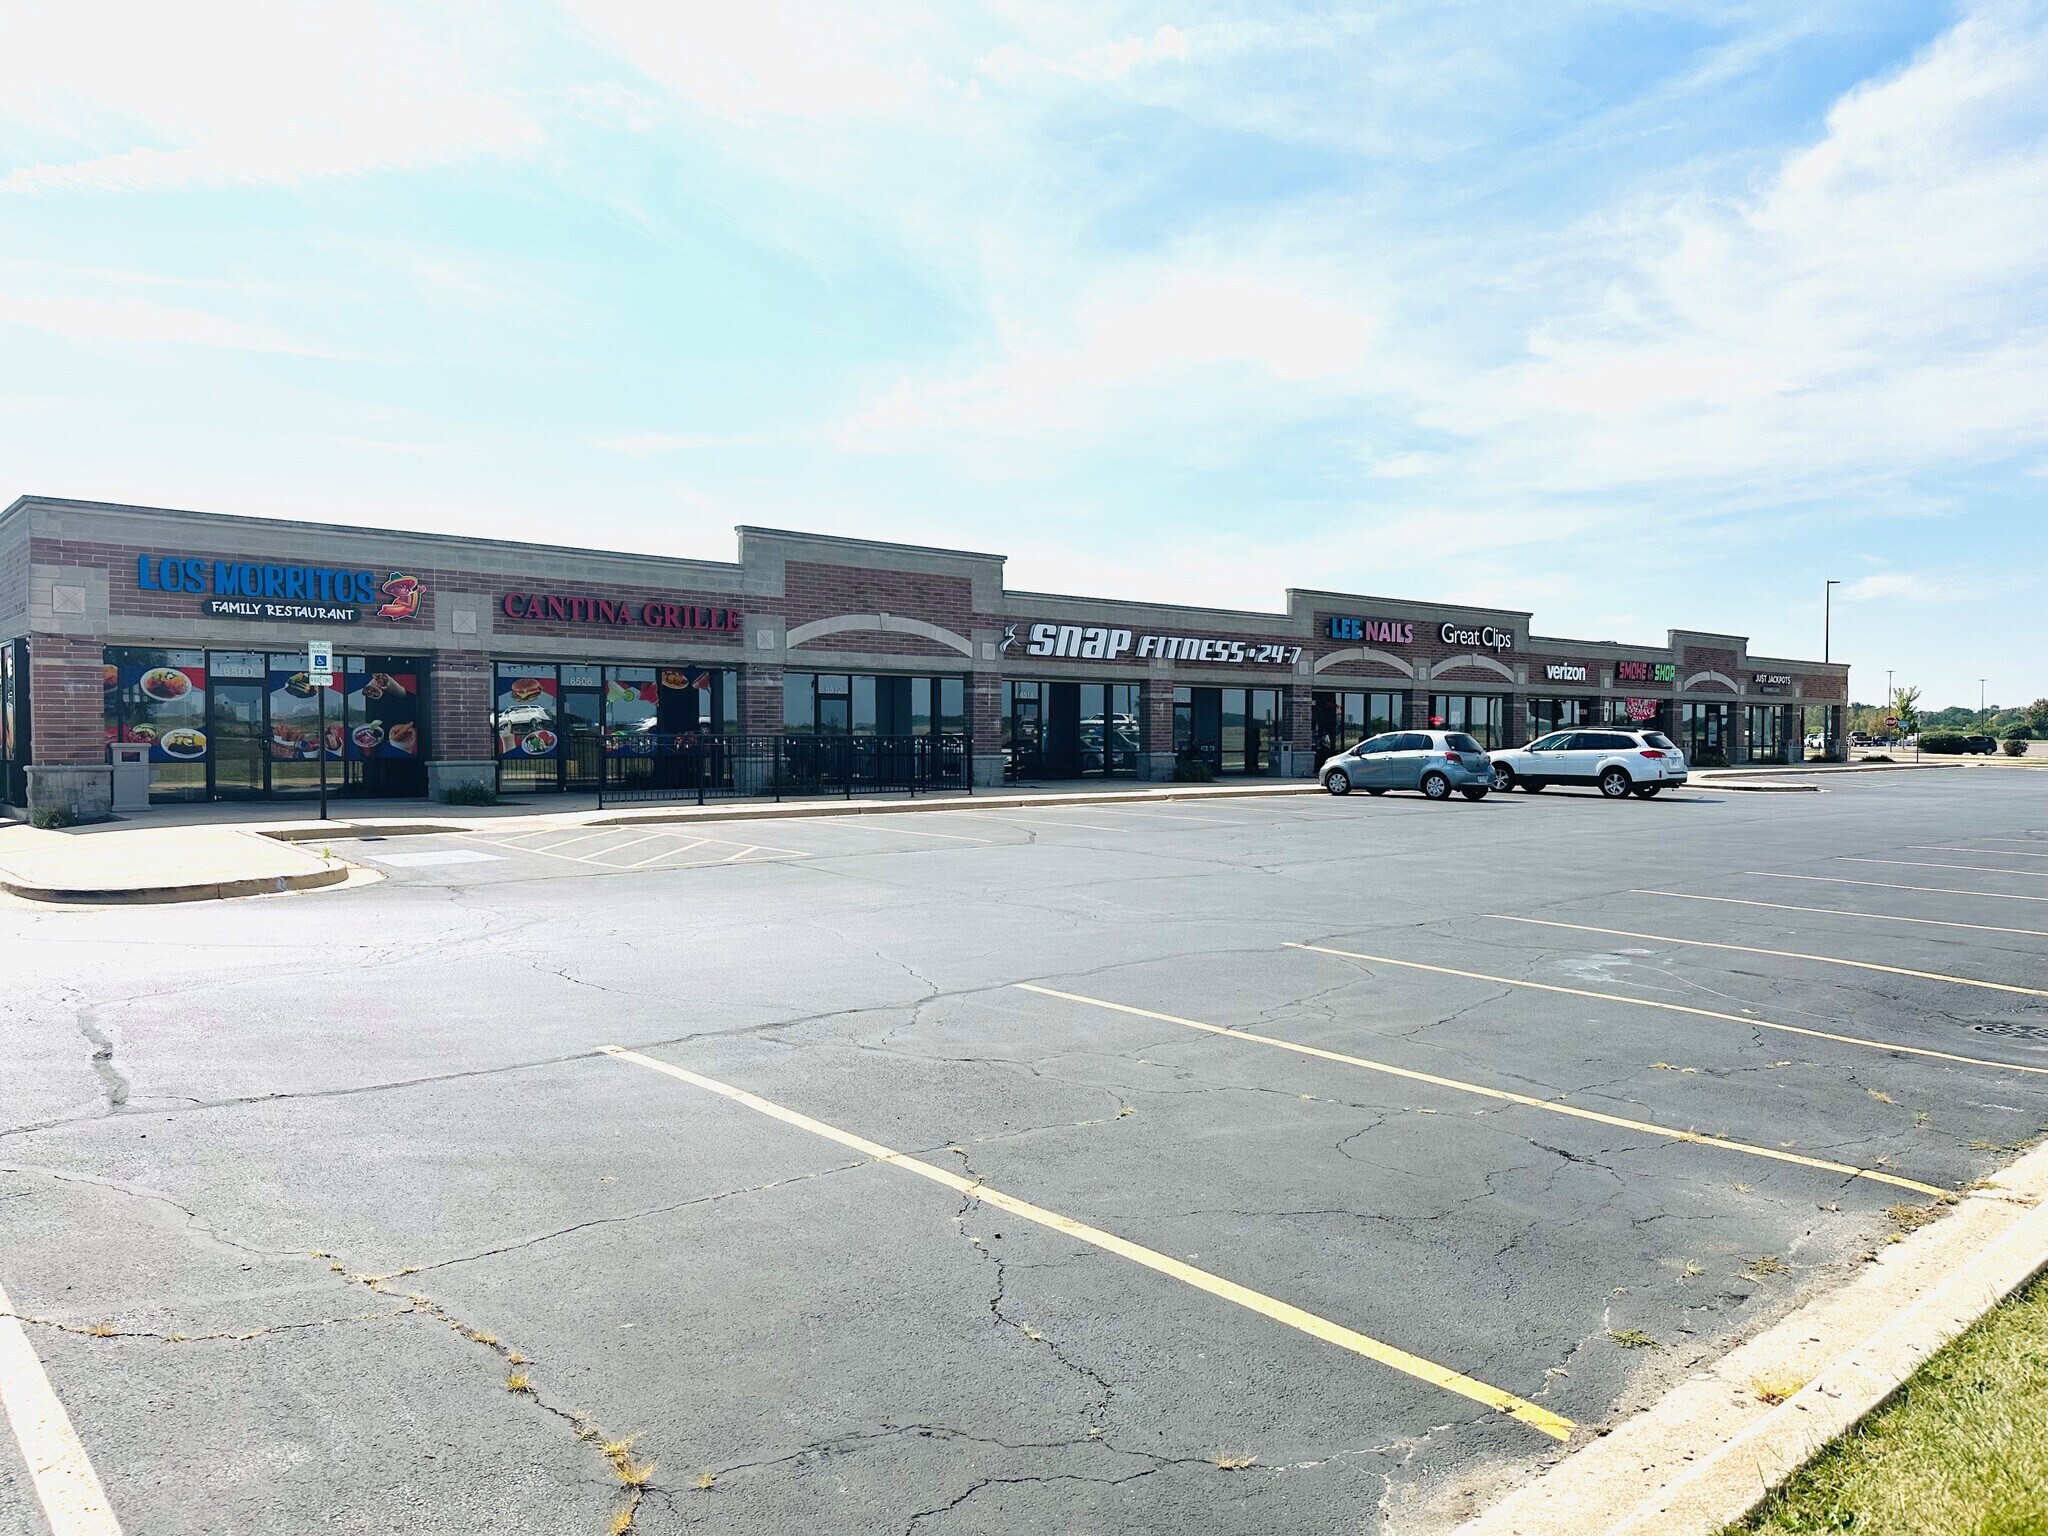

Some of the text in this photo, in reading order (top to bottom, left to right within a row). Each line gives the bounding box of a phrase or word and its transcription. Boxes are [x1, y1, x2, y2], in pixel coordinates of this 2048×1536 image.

[138, 554, 375, 603] LOS MORRITOS
[211, 601, 354, 620] FAMILY RESTAURANT
[503, 592, 740, 631] CANTINA GRILLE
[1331, 617, 1413, 644] LEE NAILS
[1441, 622, 1511, 653] Great Clips
[1138, 635, 1246, 663] FITNESS
[223, 666, 253, 677] 6500
[570, 677, 593, 686] 6506
[1546, 662, 1586, 681] verizon
[1619, 662, 1676, 682] SMOKE SHOP
